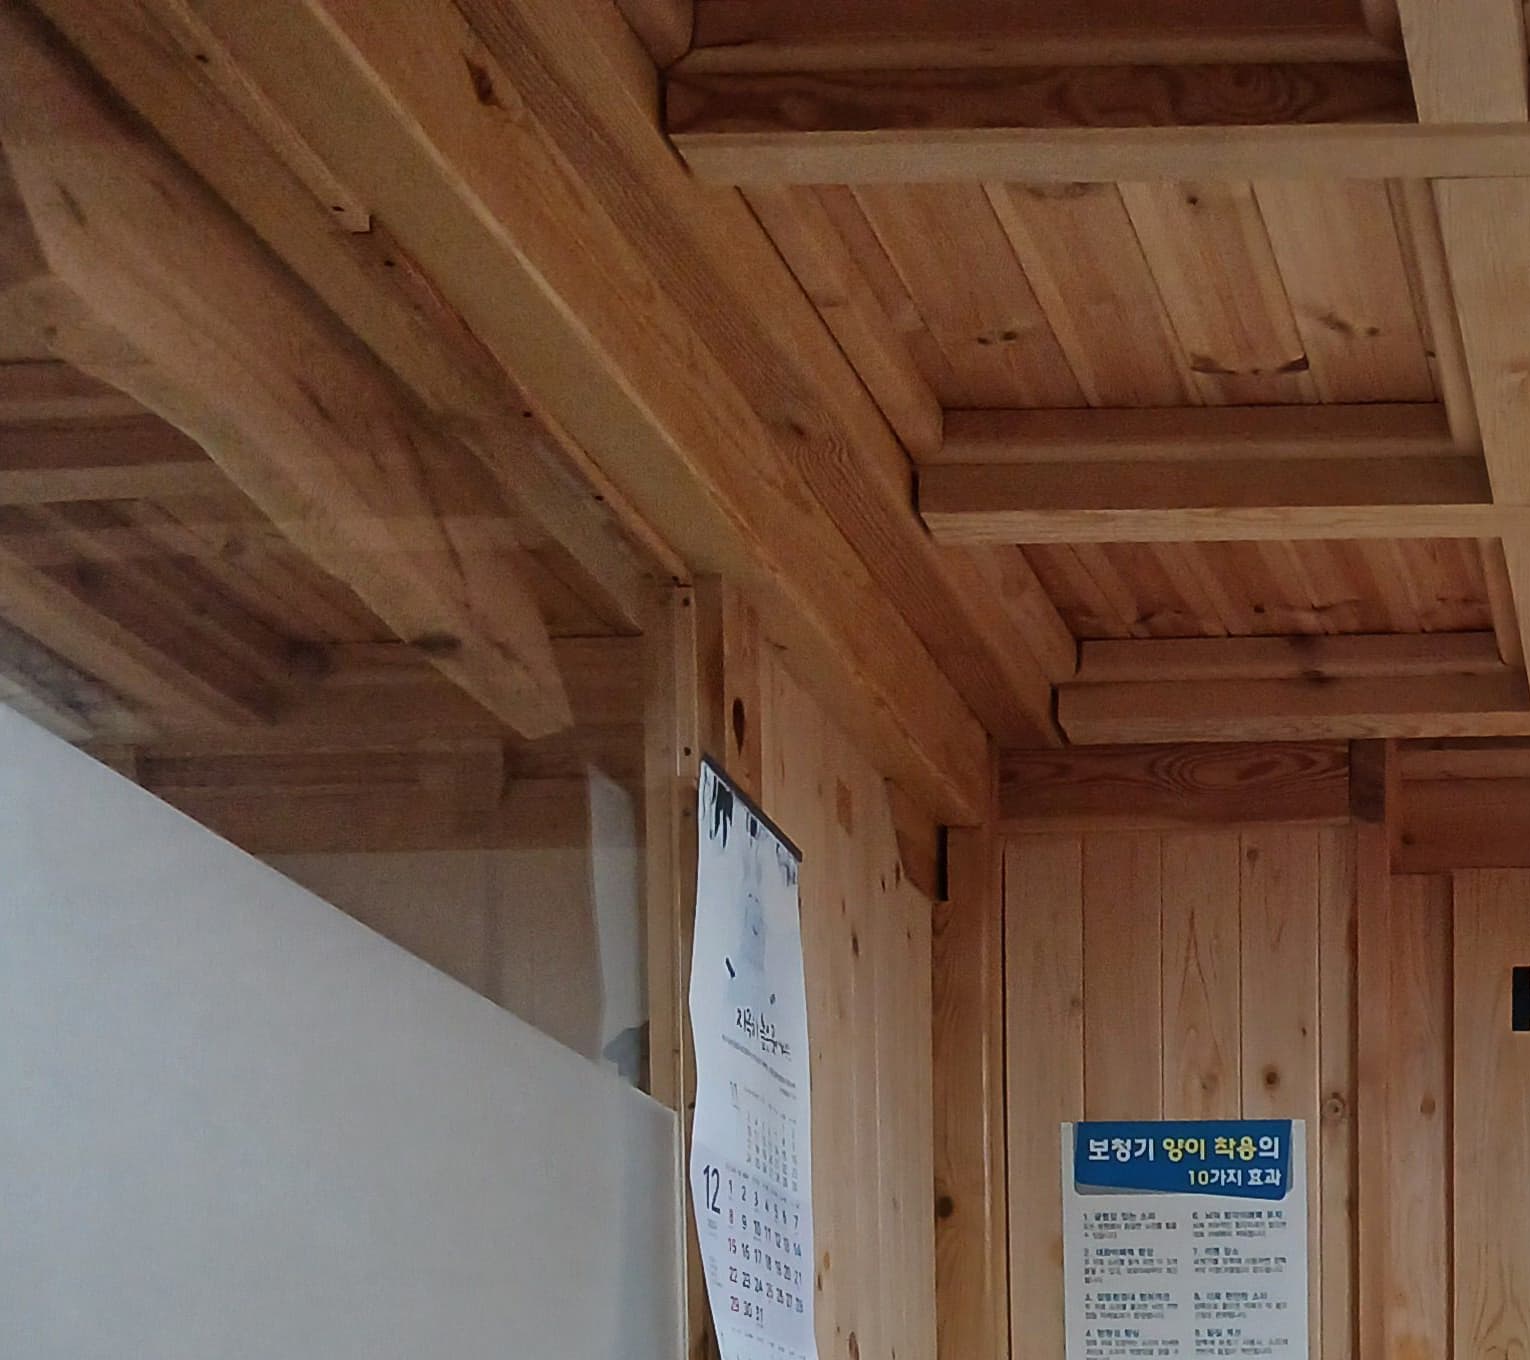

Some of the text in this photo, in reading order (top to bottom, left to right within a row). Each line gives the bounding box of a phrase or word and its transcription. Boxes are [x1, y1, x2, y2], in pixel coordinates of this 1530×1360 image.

[1089, 1136, 1280, 1162] 보청기 양이 착용의
[703, 1165, 721, 1214] 12
[1188, 1168, 1282, 1187] 10가지 효과
